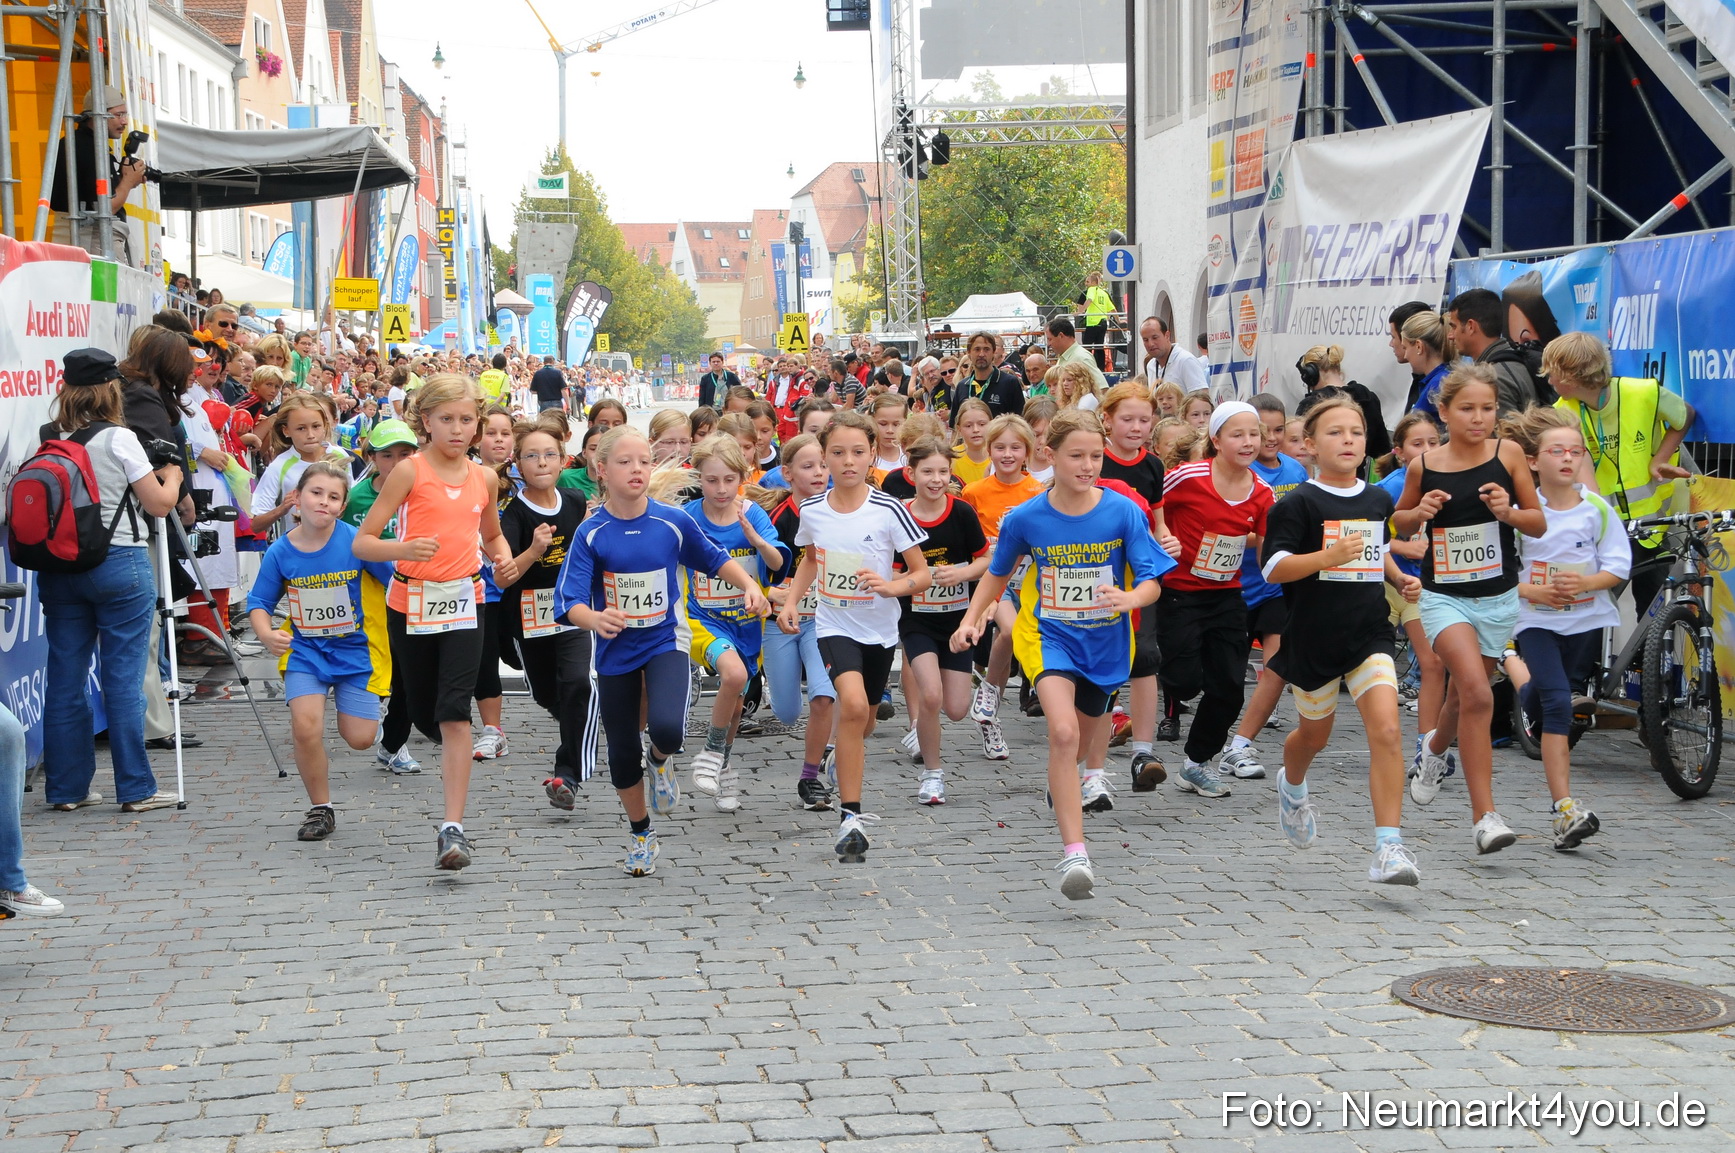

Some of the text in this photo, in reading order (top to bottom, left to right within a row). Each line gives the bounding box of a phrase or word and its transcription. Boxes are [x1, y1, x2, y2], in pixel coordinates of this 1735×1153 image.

[631, 14, 657, 28] POTAIN
[540, 180, 562, 188] DAV
[438, 209, 457, 298] HOTEL
[1298, 212, 1450, 289] PFLEIDERER
[334, 286, 376, 295] Schnupper-
[348, 295, 362, 303] lauf
[806, 289, 832, 298] swn
[1573, 277, 1598, 304] maxi
[385, 304, 407, 313] Block
[1611, 280, 1661, 351] maxi
[26, 299, 62, 338] Audi
[388, 316, 405, 335] A
[789, 325, 805, 345] A
[1448, 531, 1479, 544] Sophie
[1047, 538, 1123, 556] NEUMARKTER
[1451, 544, 1496, 565] 7006
[1047, 552, 1110, 566] STADTLAUF
[1213, 552, 1242, 567] 7207
[291, 569, 359, 586] NEUMARKTER
[827, 572, 869, 591] 729
[1058, 567, 1100, 579] Fabienne
[617, 577, 645, 589] Selina
[930, 583, 964, 598] 7203
[620, 591, 663, 609] 7145
[1059, 585, 1096, 602] 721
[305, 604, 347, 621] 7308
[427, 598, 469, 616] 7297
